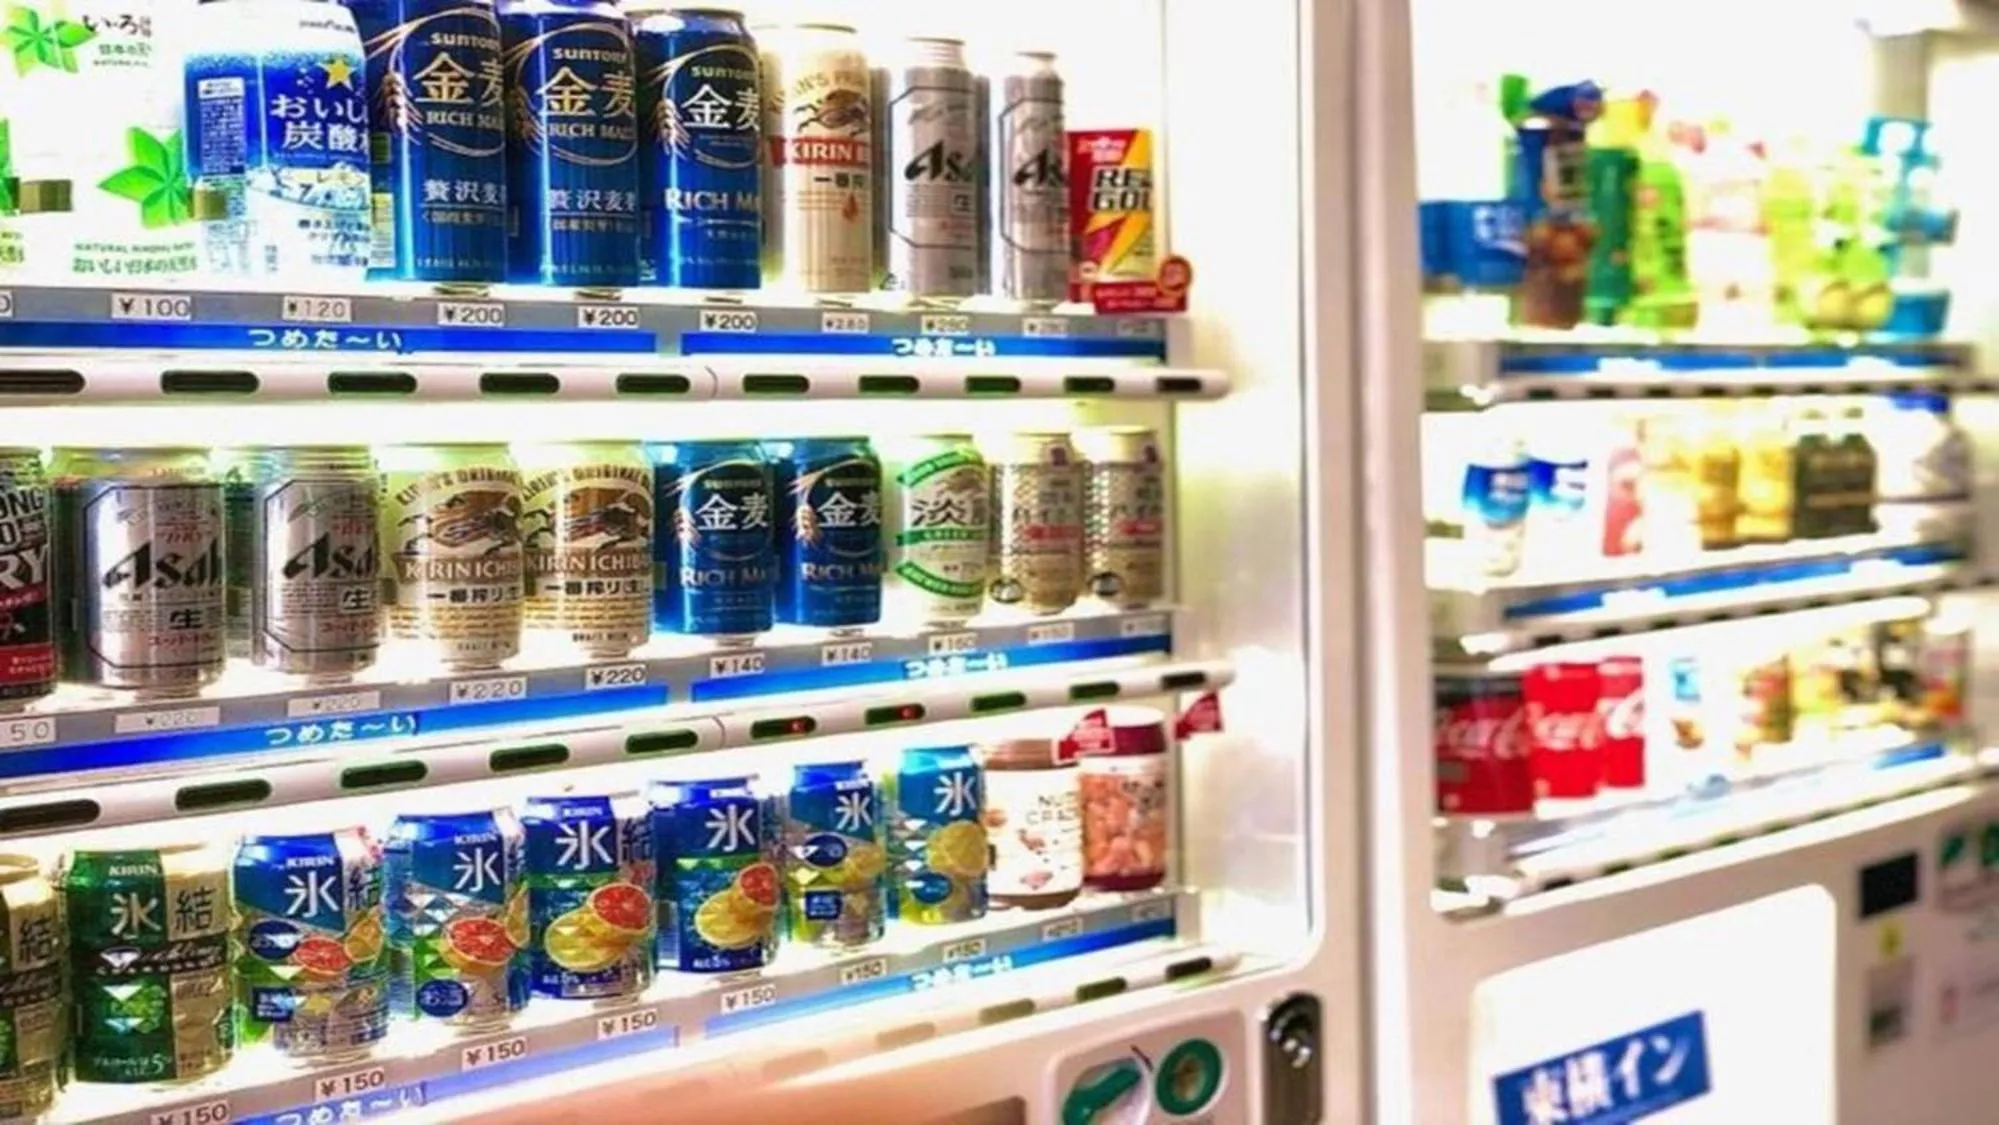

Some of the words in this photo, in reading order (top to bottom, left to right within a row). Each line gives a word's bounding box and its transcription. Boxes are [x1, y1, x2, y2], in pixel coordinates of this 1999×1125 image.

[535, 65, 636, 118] 金麦
[680, 83, 760, 132] 金麦
[664, 187, 729, 211] RICH
[442, 306, 503, 324] ¥200
[582, 308, 638, 326] ¥200
[704, 313, 757, 330] ¥200
[695, 491, 769, 531] 金麦
[817, 490, 882, 528] 金麦
[342, 586, 373, 612] 生
[168, 608, 203, 631] 生
[591, 666, 647, 686] ¥220
[455, 680, 523, 699] ¥220
[933, 771, 976, 817] 氷
[834, 791, 873, 833] 氷
[706, 804, 757, 852] 氷
[108, 865, 158, 877] KIRIN
[286, 855, 336, 868] KIRIN
[725, 988, 776, 1010] ¥150
[601, 1012, 657, 1036] ¥150
[465, 1041, 525, 1066] ¥150
[321, 1070, 386, 1097] ¥150
[158, 1103, 229, 1125] ¥150
